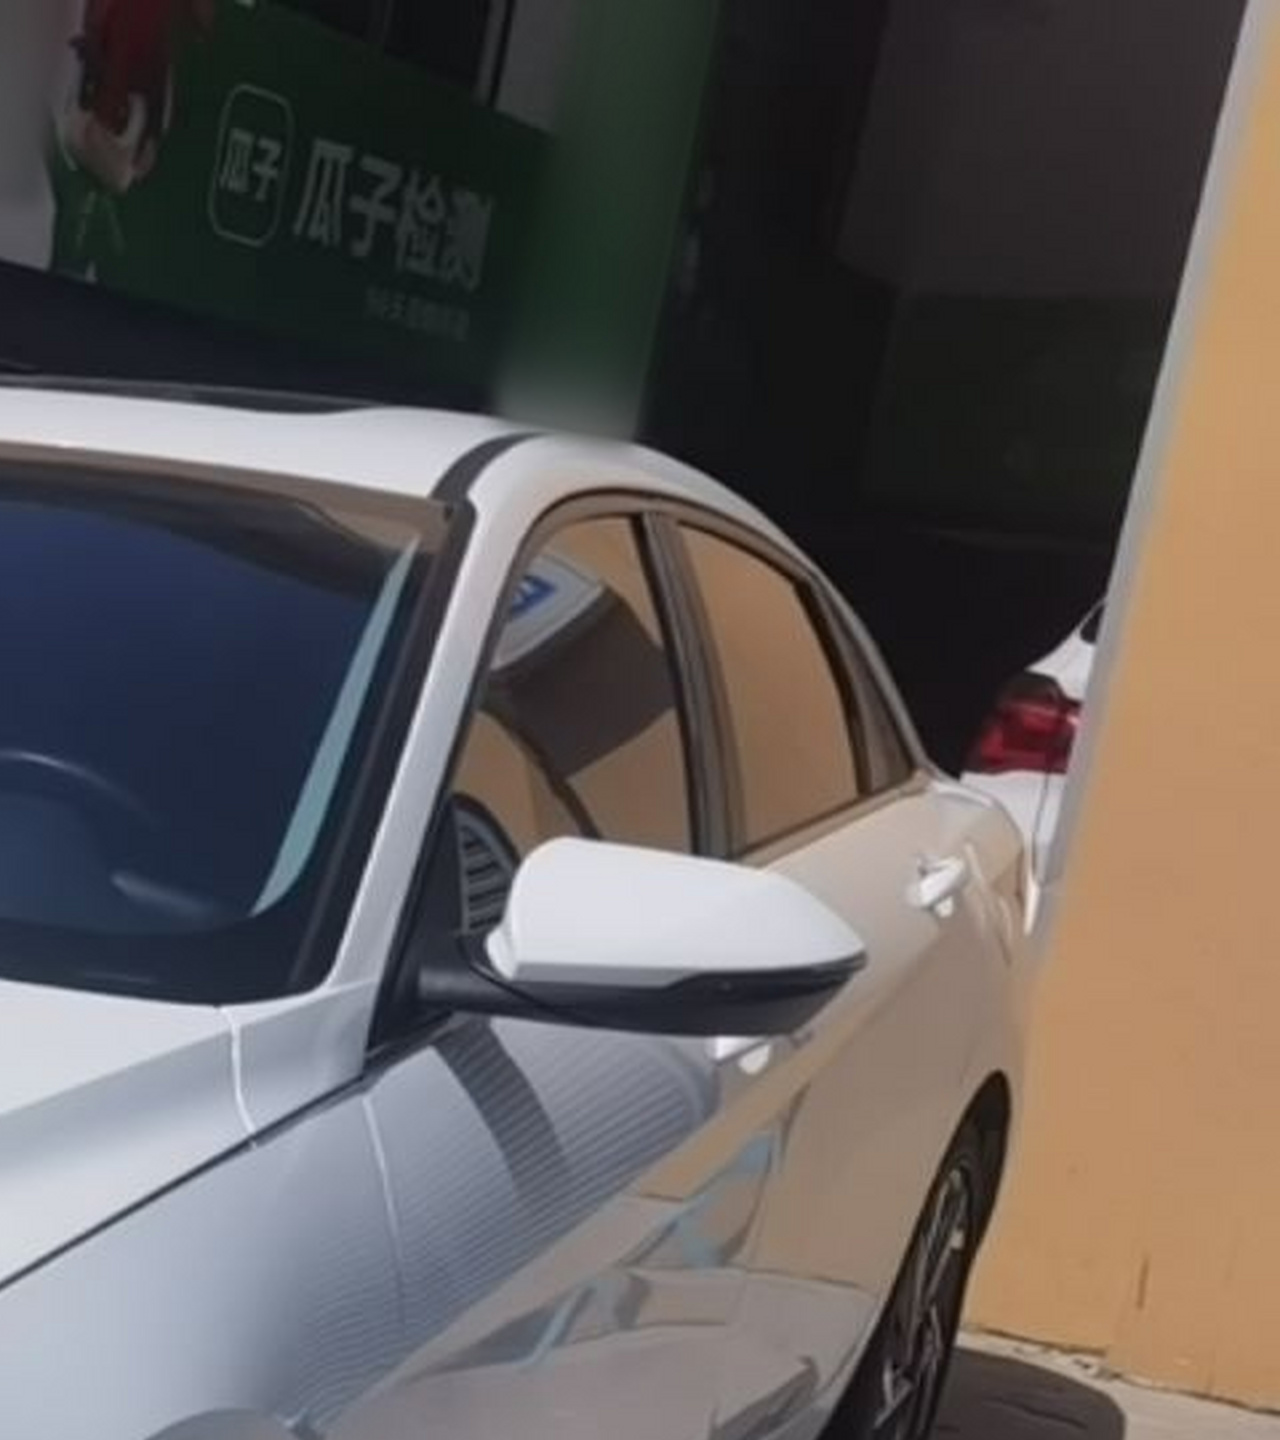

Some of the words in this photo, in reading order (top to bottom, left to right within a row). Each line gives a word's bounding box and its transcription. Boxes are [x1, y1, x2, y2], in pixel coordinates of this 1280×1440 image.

[219, 127, 283, 202] 瓜子
[291, 136, 495, 293] 瓜子检测
